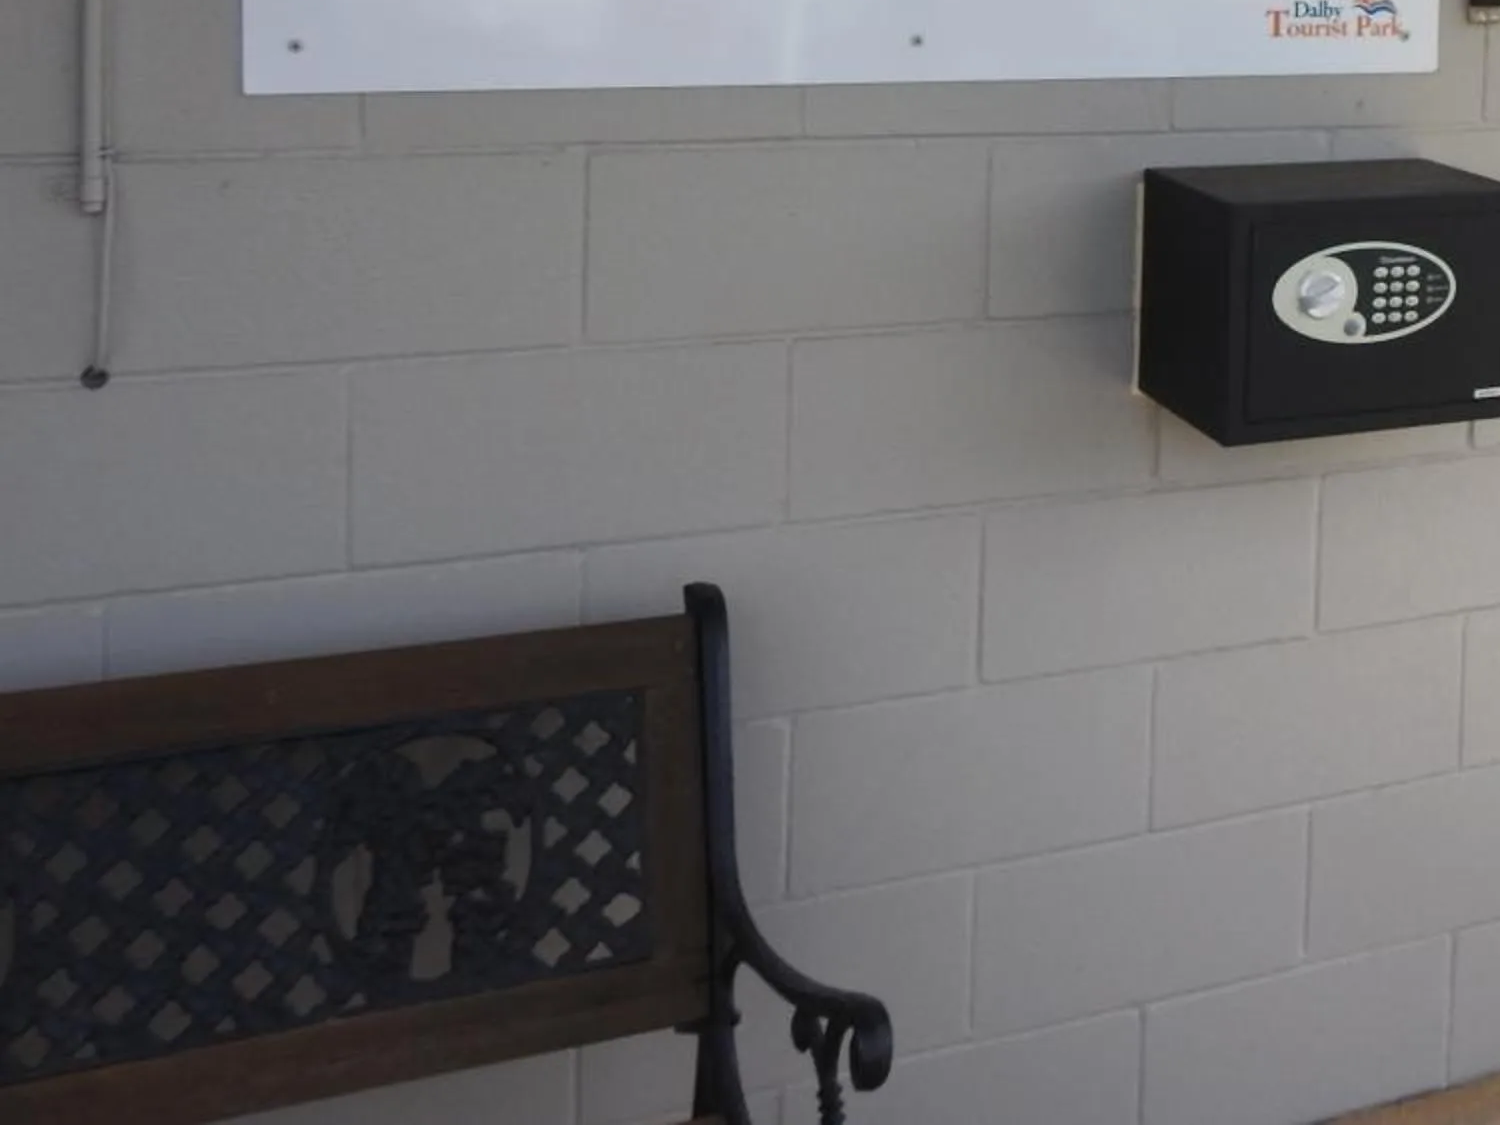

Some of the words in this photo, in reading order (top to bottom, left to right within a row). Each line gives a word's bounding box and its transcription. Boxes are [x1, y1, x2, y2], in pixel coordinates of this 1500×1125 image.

[1294, 0, 1343, 20] Dalby
[1266, 9, 1348, 38] Tourist
[1356, 15, 1404, 38] Park
